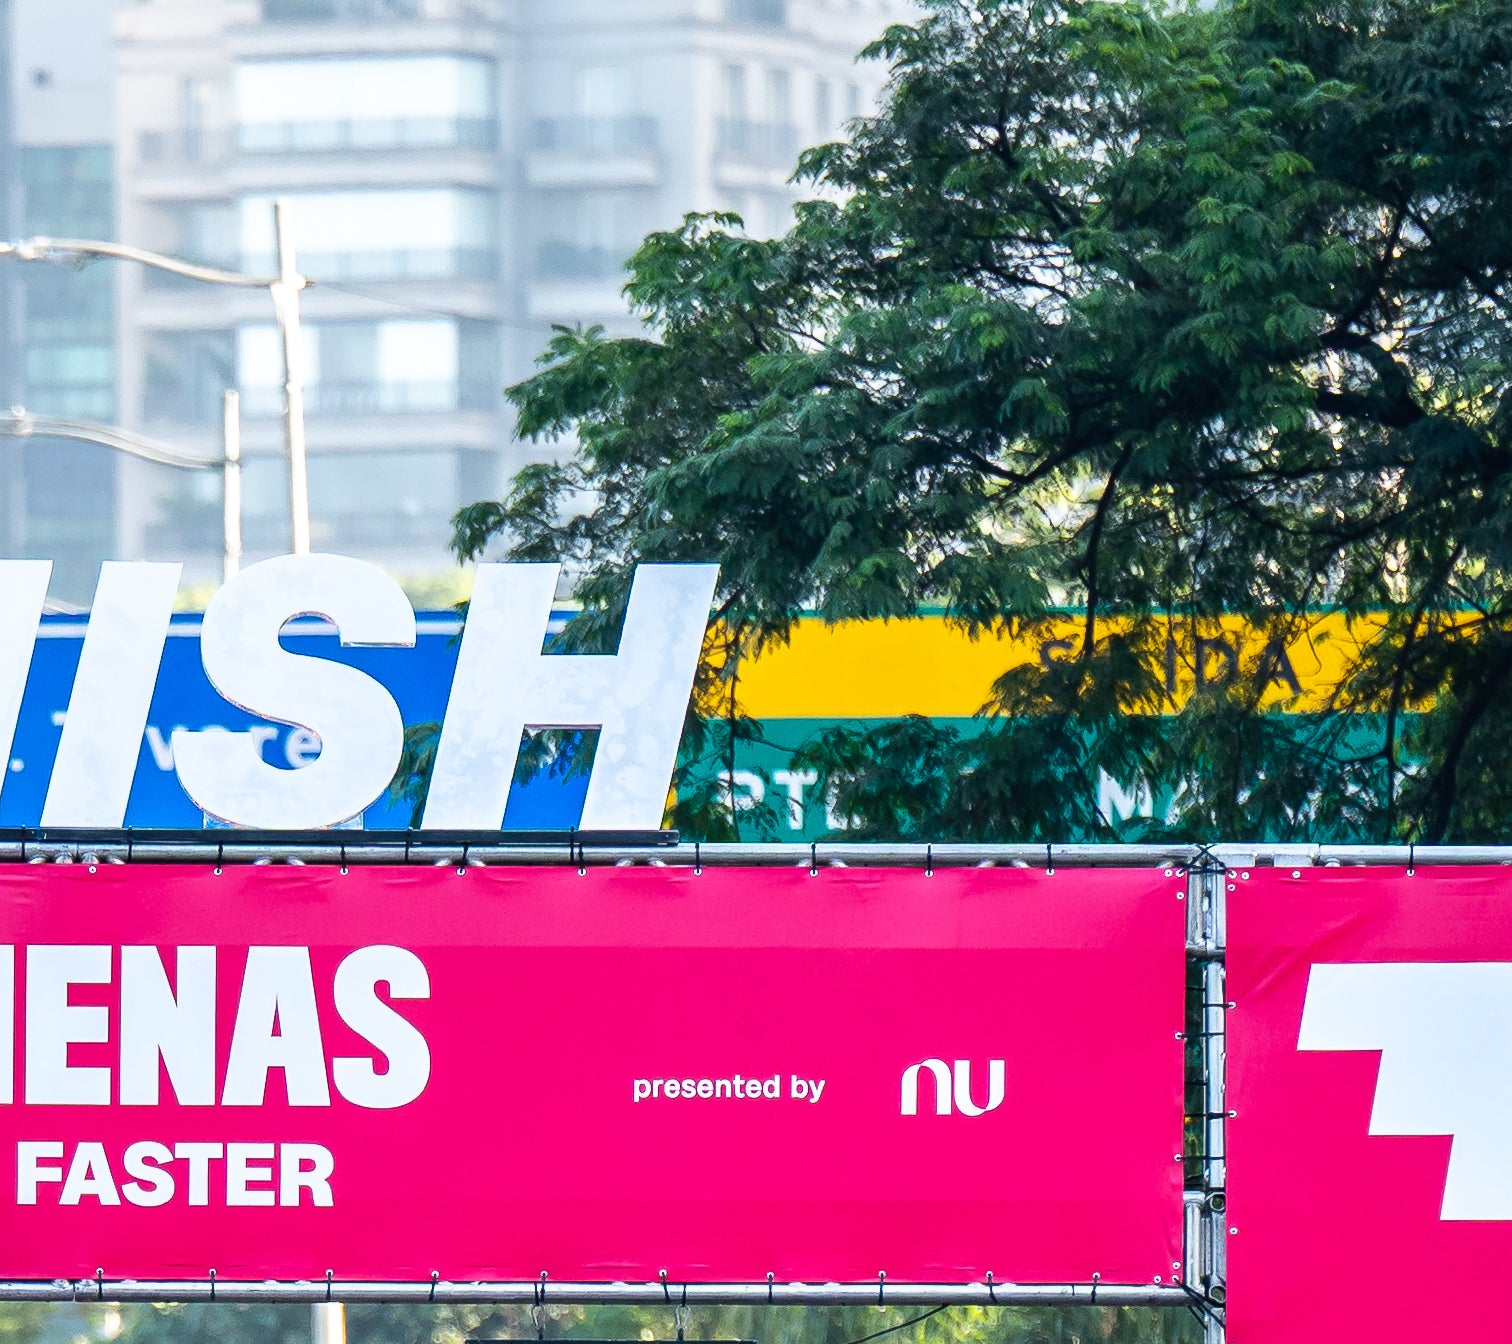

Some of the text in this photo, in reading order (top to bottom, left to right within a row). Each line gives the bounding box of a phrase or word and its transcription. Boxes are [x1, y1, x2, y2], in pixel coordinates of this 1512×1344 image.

[633, 1075, 825, 1103] presented by
[16, 1141, 334, 1207] FASTER
